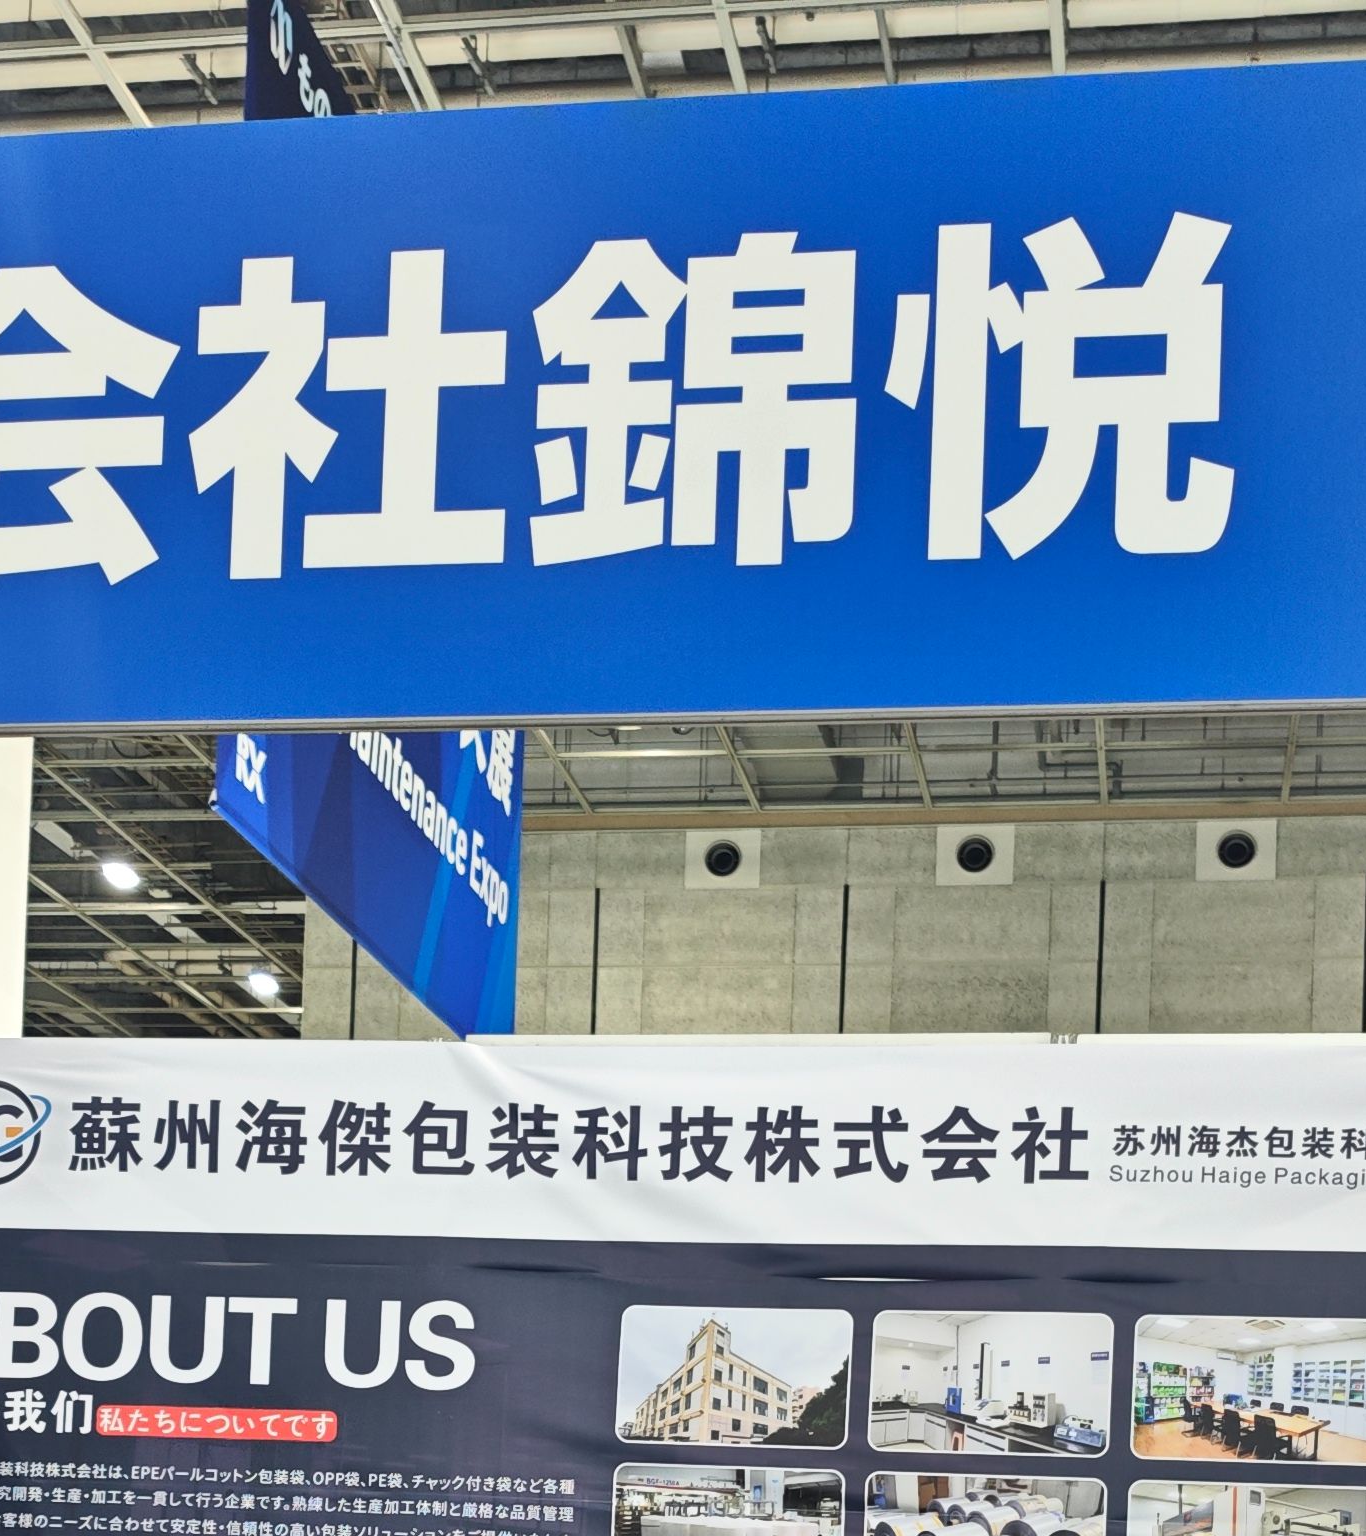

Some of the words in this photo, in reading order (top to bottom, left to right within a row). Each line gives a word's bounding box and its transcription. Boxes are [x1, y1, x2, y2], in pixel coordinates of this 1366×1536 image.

[349, 731, 468, 876] aintenance
[469, 829, 509, 928] Expo
[67, 1095, 1089, 1185] 蘇州海傑包装科技株式会社
[1109, 1164, 1194, 1186] Suzhou
[1200, 1166, 1267, 1190] Haige
[325, 1298, 476, 1391] US
[99, 1406, 335, 1440] 私たちについてです
